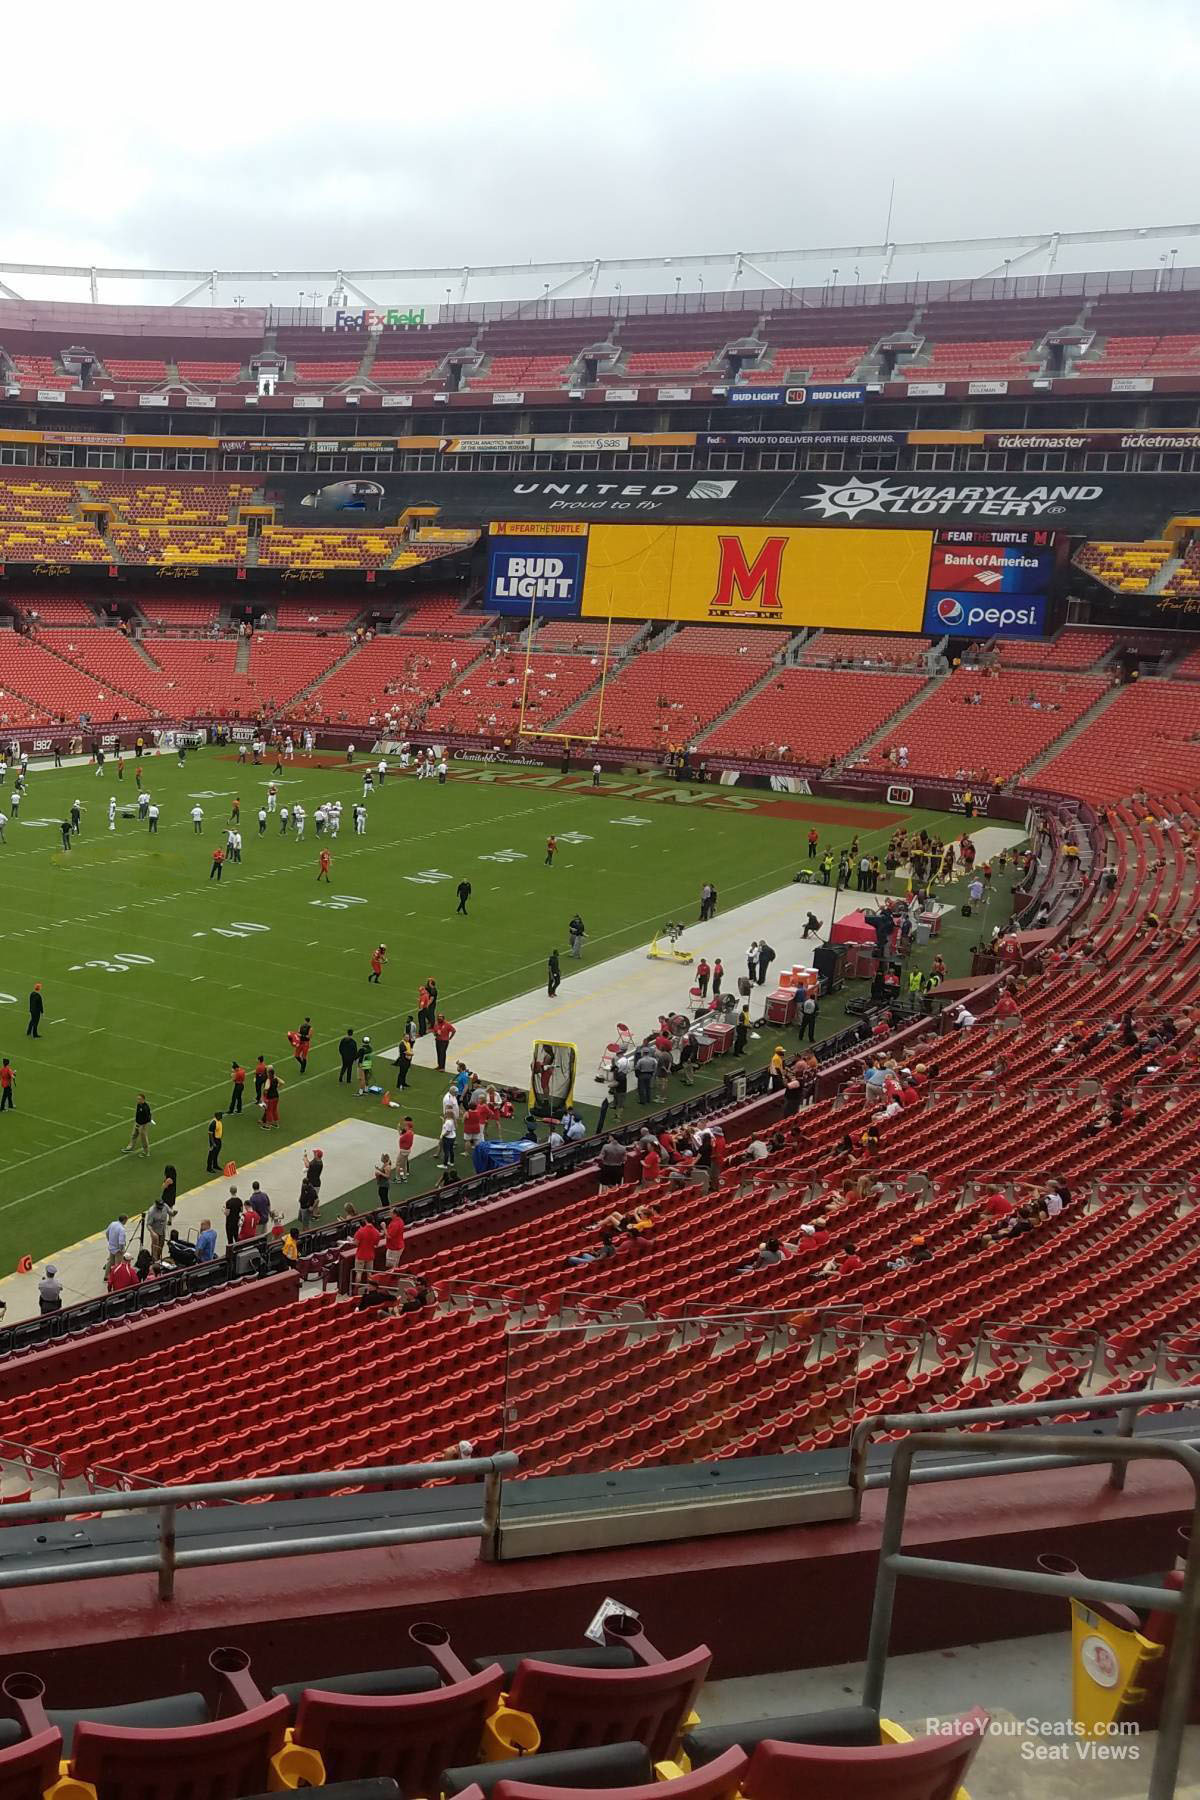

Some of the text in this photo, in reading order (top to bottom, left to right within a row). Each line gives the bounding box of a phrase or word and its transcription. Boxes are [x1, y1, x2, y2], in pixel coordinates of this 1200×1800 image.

[336, 308, 425, 326] FedExField
[732, 392, 780, 401] BUD LIGHT
[812, 391, 861, 400] BUD LIGHT
[604, 438, 621, 447] sas
[737, 436, 767, 444] PROUD
[767, 436, 778, 444] TO
[779, 436, 813, 444] DELIVER
[832, 435, 849, 443] THE
[850, 434, 895, 443] REDSKINS.
[997, 435, 1087, 448] ticketmaster
[512, 483, 679, 495] UNITED
[902, 486, 1104, 500] MARYLAND
[549, 500, 663, 510] Proud to fly
[508, 557, 563, 578] BUD
[944, 554, 1039, 568] Bank of America
[710, 535, 790, 608] M
[495, 578, 573, 598] LIGHT
[968, 606, 1036, 626] pepsi
[33, 740, 52, 750] 1987
[453, 750, 544, 767] Charitable Foundation
[309, 894, 369, 910] 50
[211, 921, 271, 939] 40
[84, 952, 157, 973] 30
